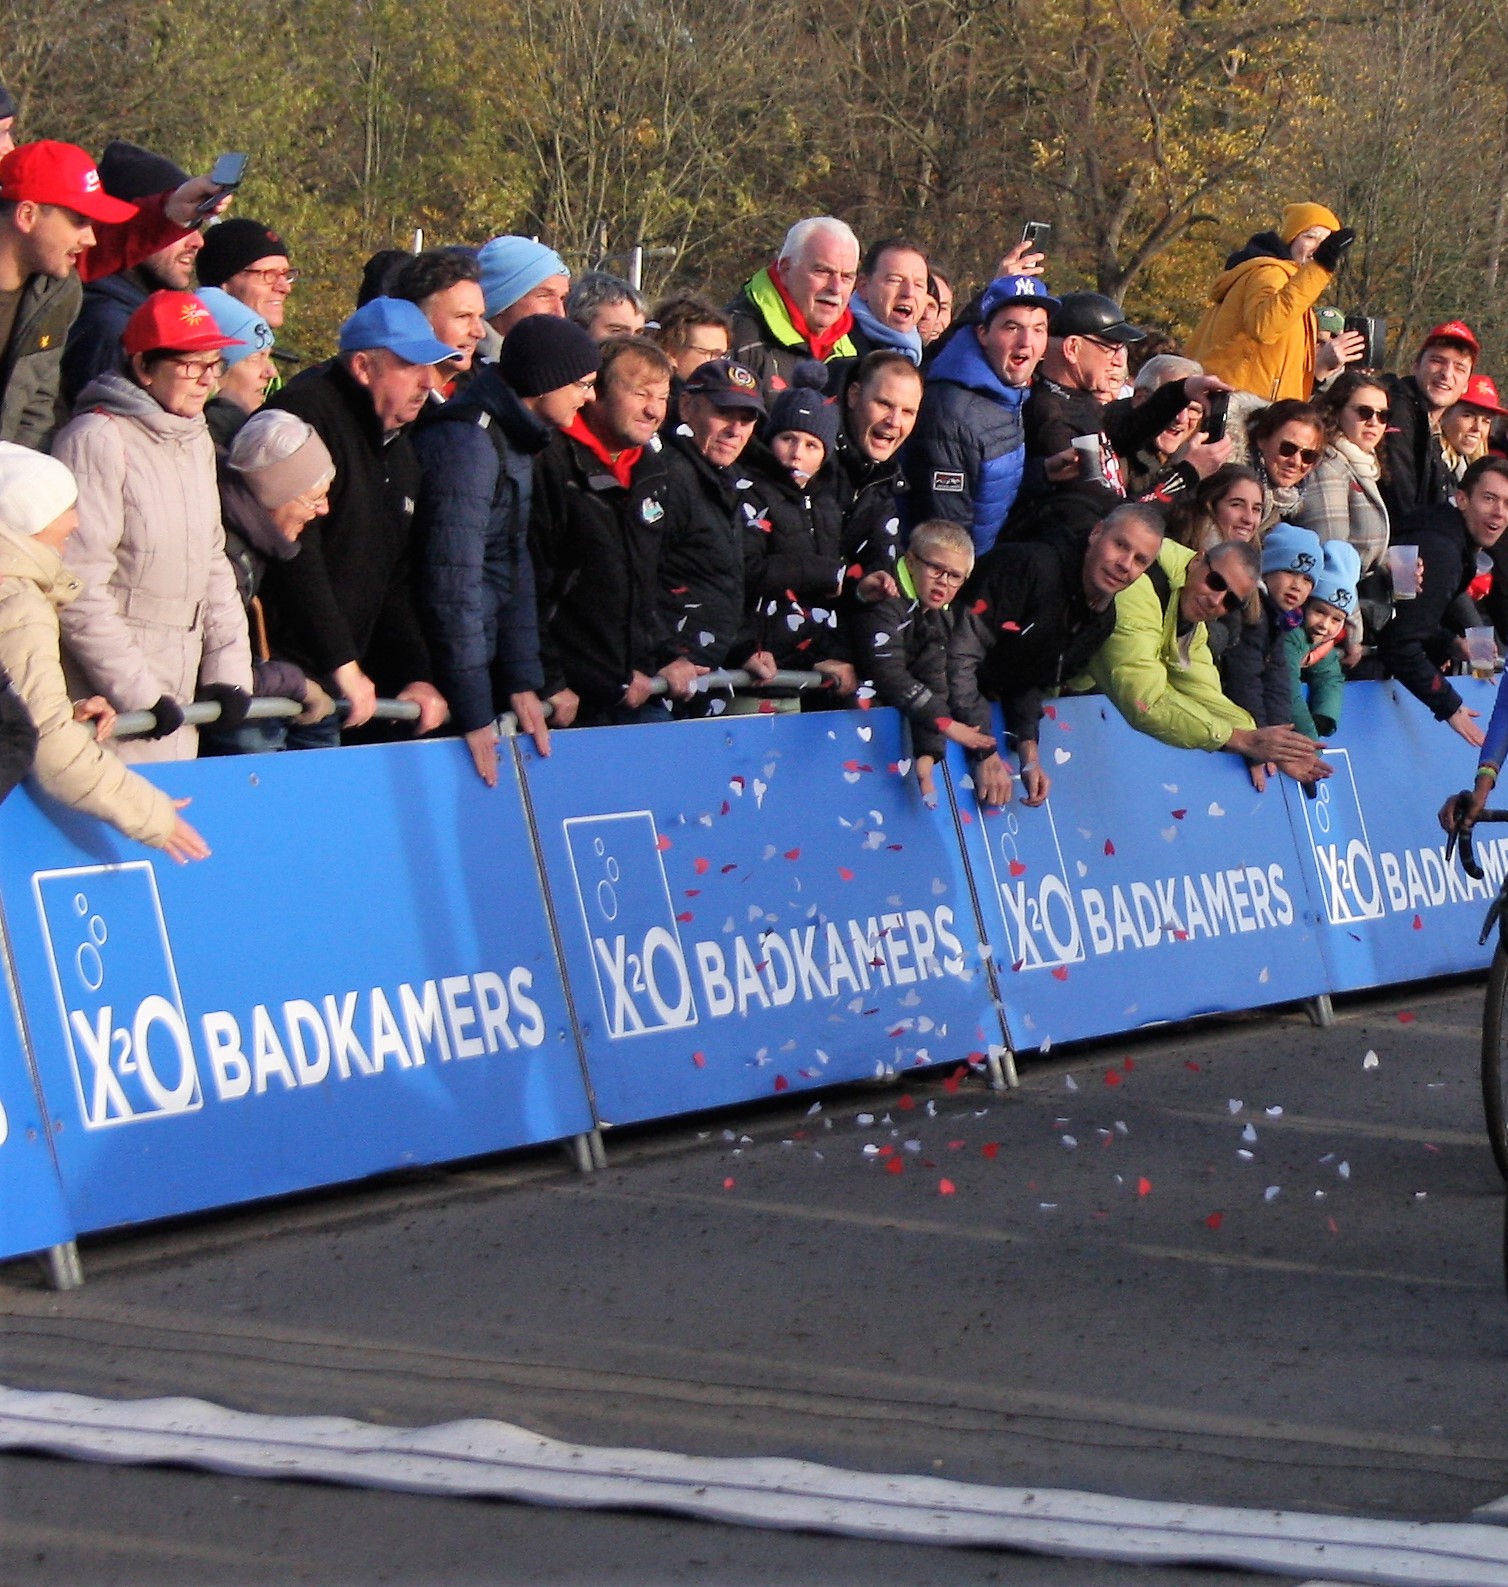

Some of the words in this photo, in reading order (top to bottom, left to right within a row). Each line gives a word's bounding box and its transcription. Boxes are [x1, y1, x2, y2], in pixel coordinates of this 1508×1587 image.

[696, 905, 965, 1016] BADKAMERS
[1082, 863, 1293, 954] BADKAMERS
[202, 966, 545, 1099] BADKAMERS
